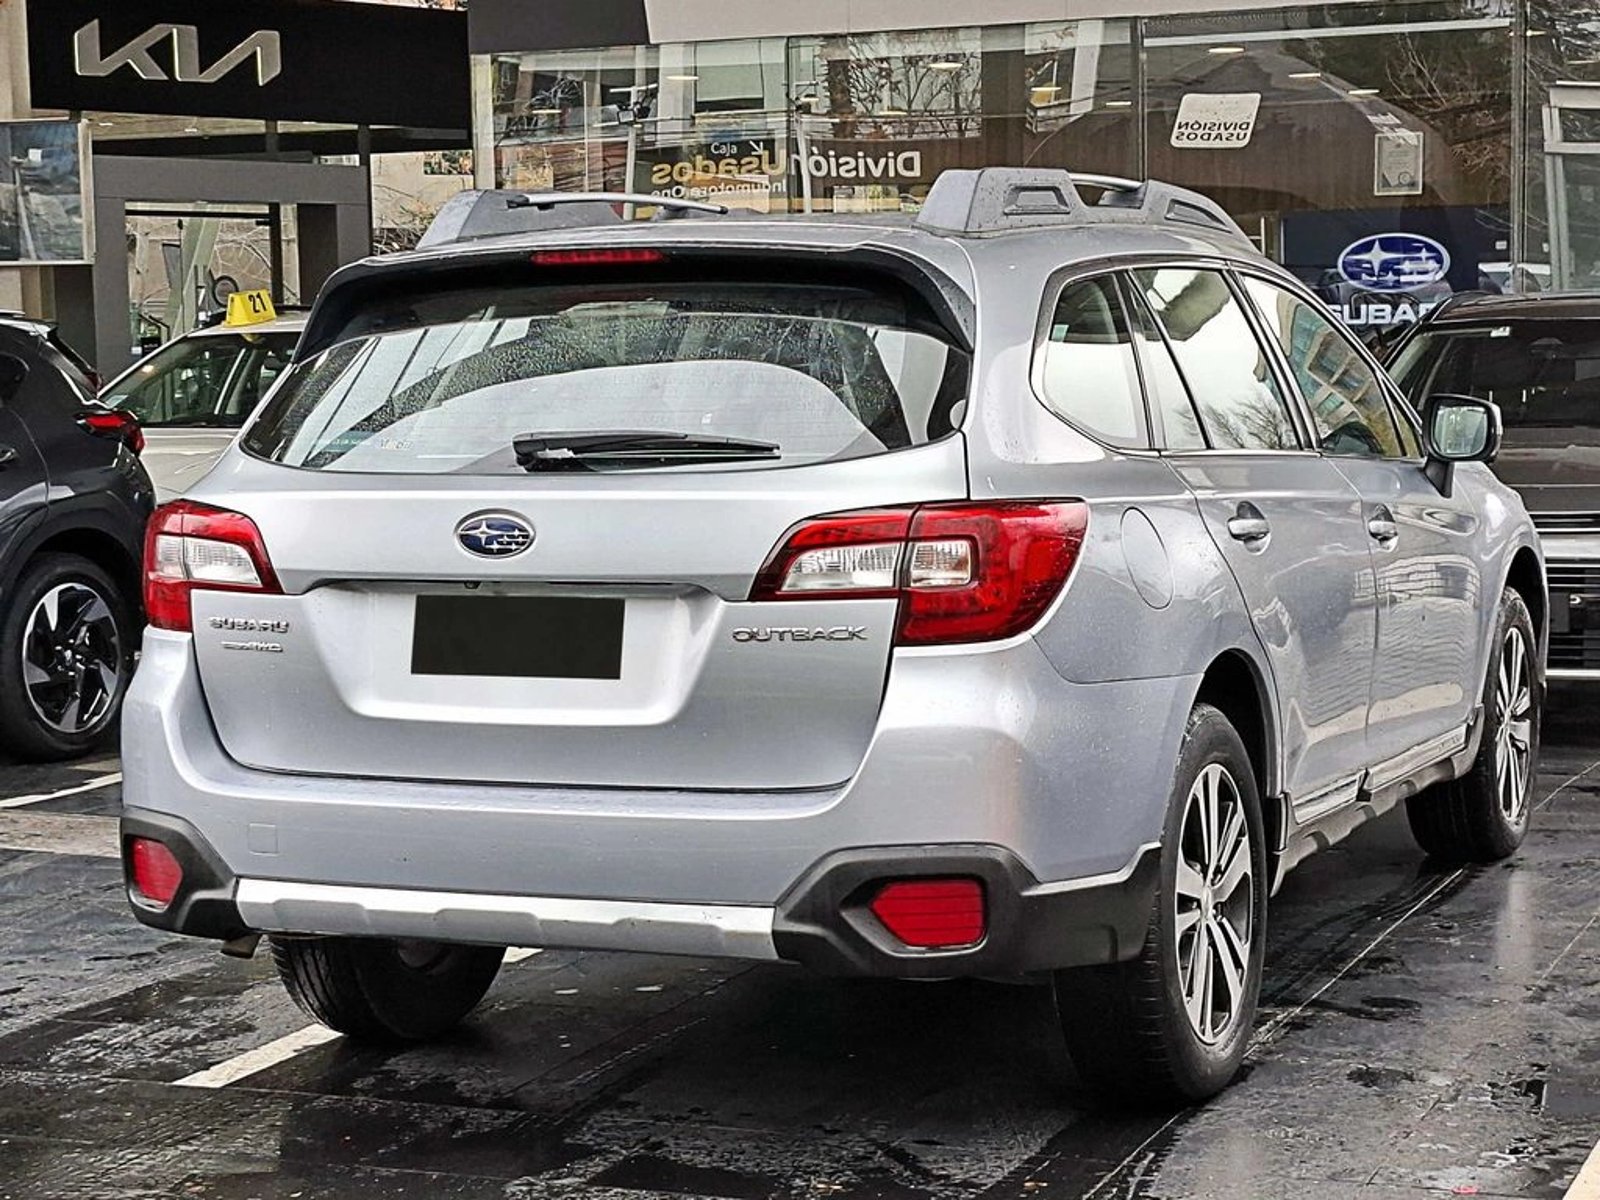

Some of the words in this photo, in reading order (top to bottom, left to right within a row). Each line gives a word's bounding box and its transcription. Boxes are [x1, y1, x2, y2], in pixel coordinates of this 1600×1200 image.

[74, 18, 281, 87] KIA
[248, 292, 267, 313] 21
[208, 616, 289, 634] SUBARU
[732, 625, 868, 643] OUTBACK
